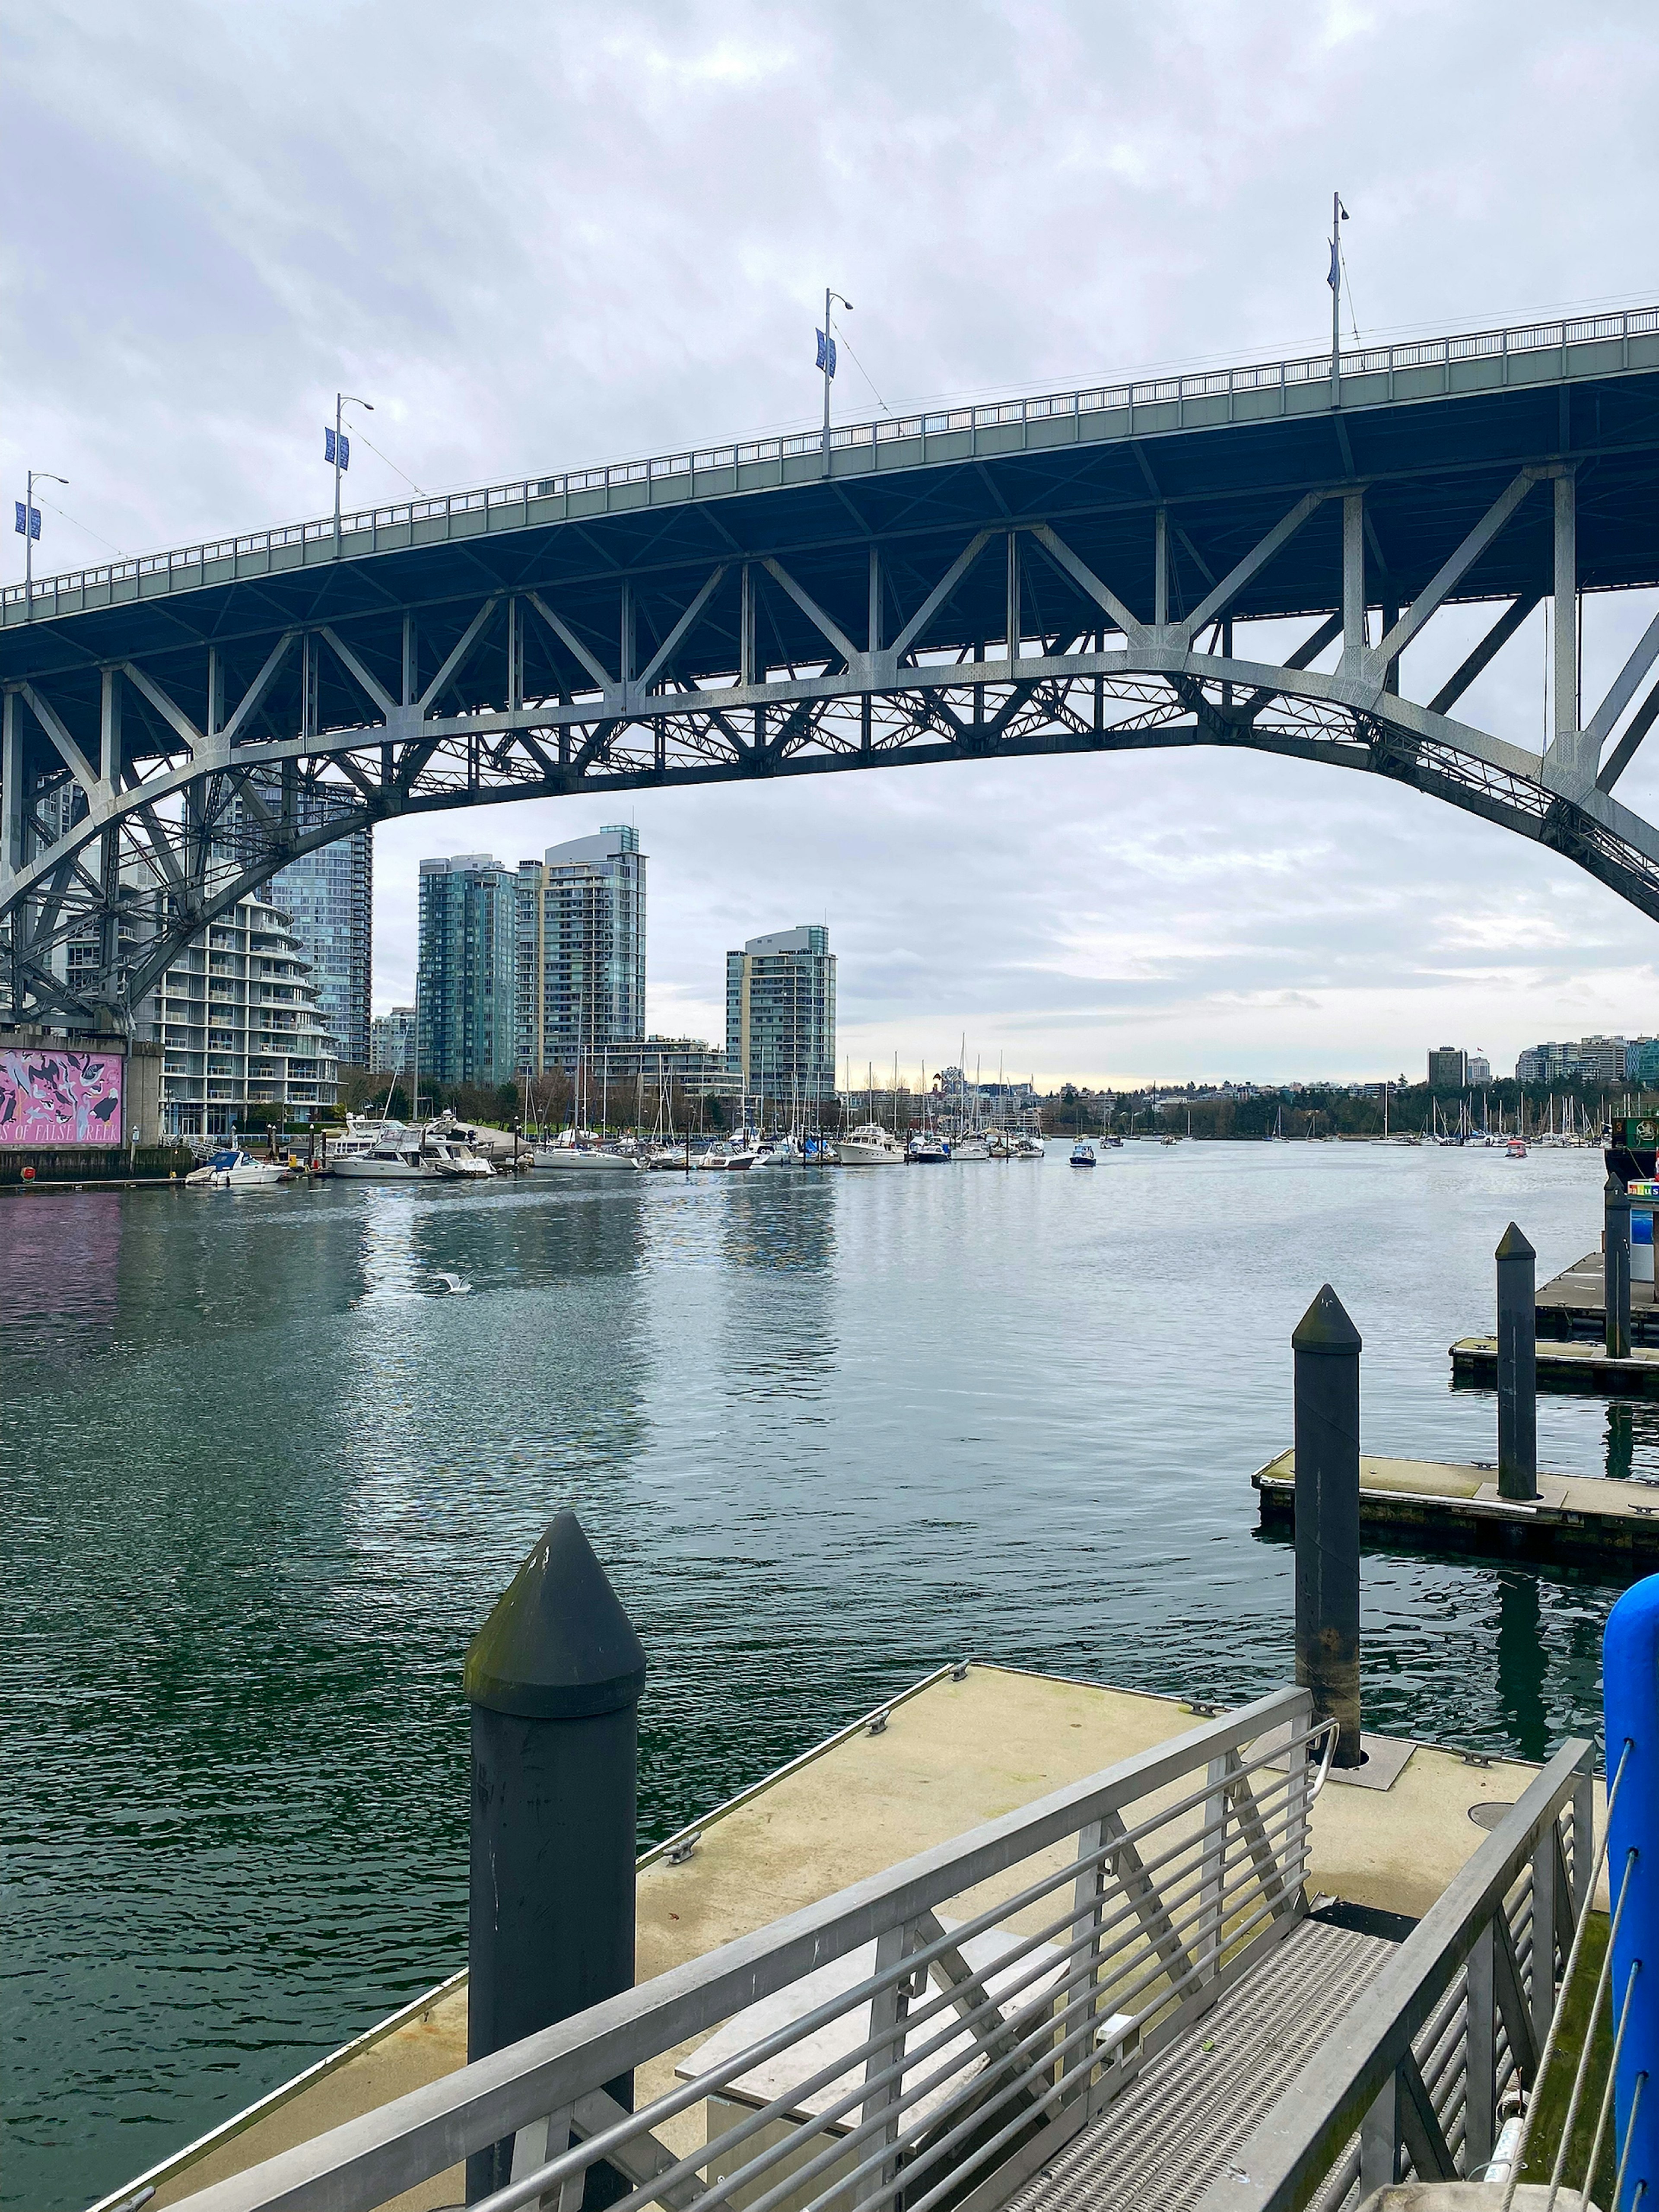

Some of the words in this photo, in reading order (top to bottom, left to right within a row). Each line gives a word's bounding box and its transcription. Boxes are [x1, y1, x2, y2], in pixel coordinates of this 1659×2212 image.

[15, 1124, 30, 1141] OF
[35, 1124, 74, 1141] FALSE
[79, 1124, 118, 1141] CREEK
[1616, 1122, 1622, 1131] 3
